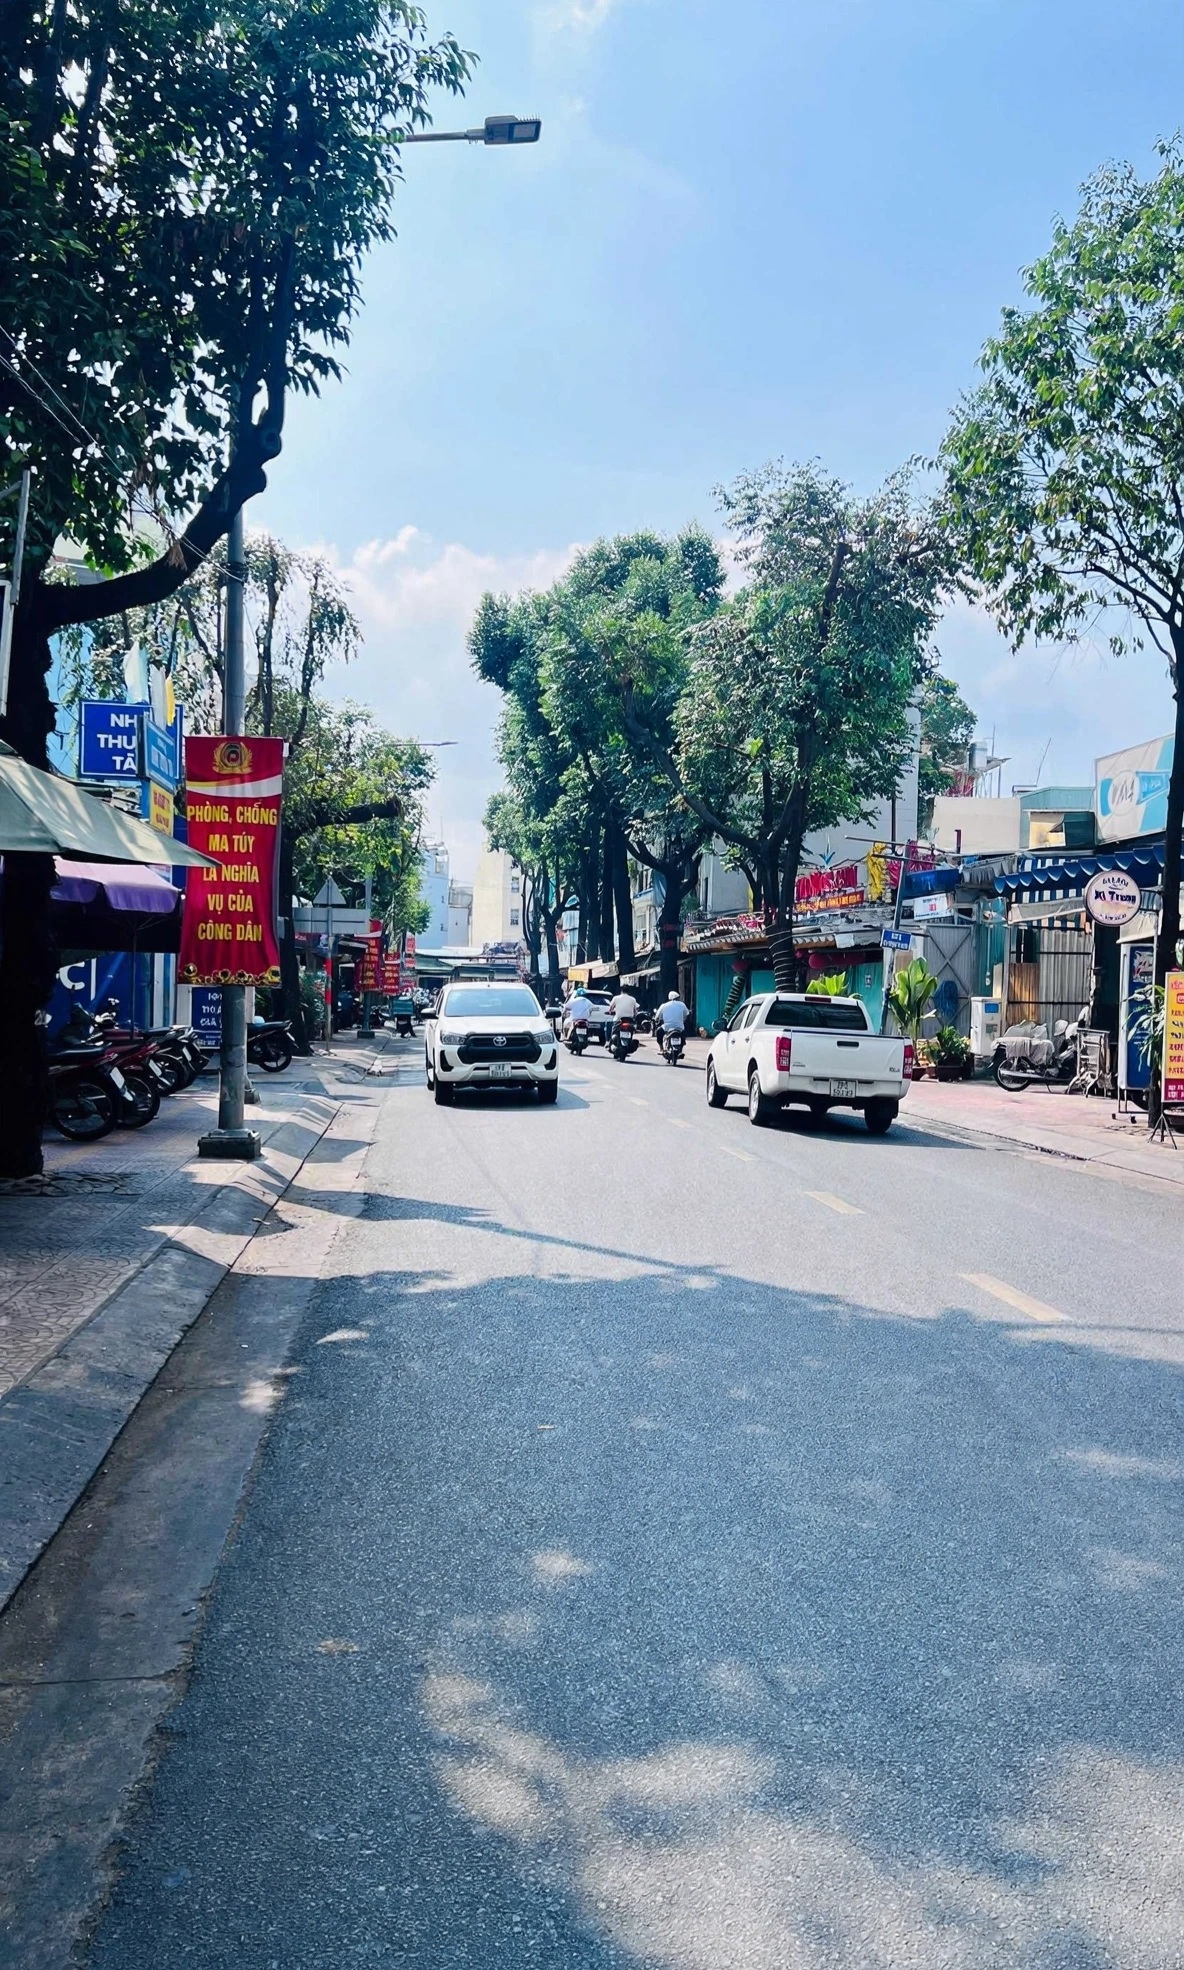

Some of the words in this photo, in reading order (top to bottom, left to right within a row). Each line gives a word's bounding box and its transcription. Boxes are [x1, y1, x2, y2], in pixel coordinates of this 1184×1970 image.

[110, 713, 137, 728] NH
[97, 734, 136, 749] THU
[187, 801, 233, 824] PHÒNG,
[236, 799, 278, 826] CHỐNG
[208, 834, 229, 852] MA
[232, 831, 255, 853] TÚY
[221, 861, 260, 883] NGHĨA
[207, 894, 224, 914] VỤ
[228, 889, 254, 912] CỦA
[198, 919, 232, 941] CÔNG
[236, 920, 262, 942] DÂN
